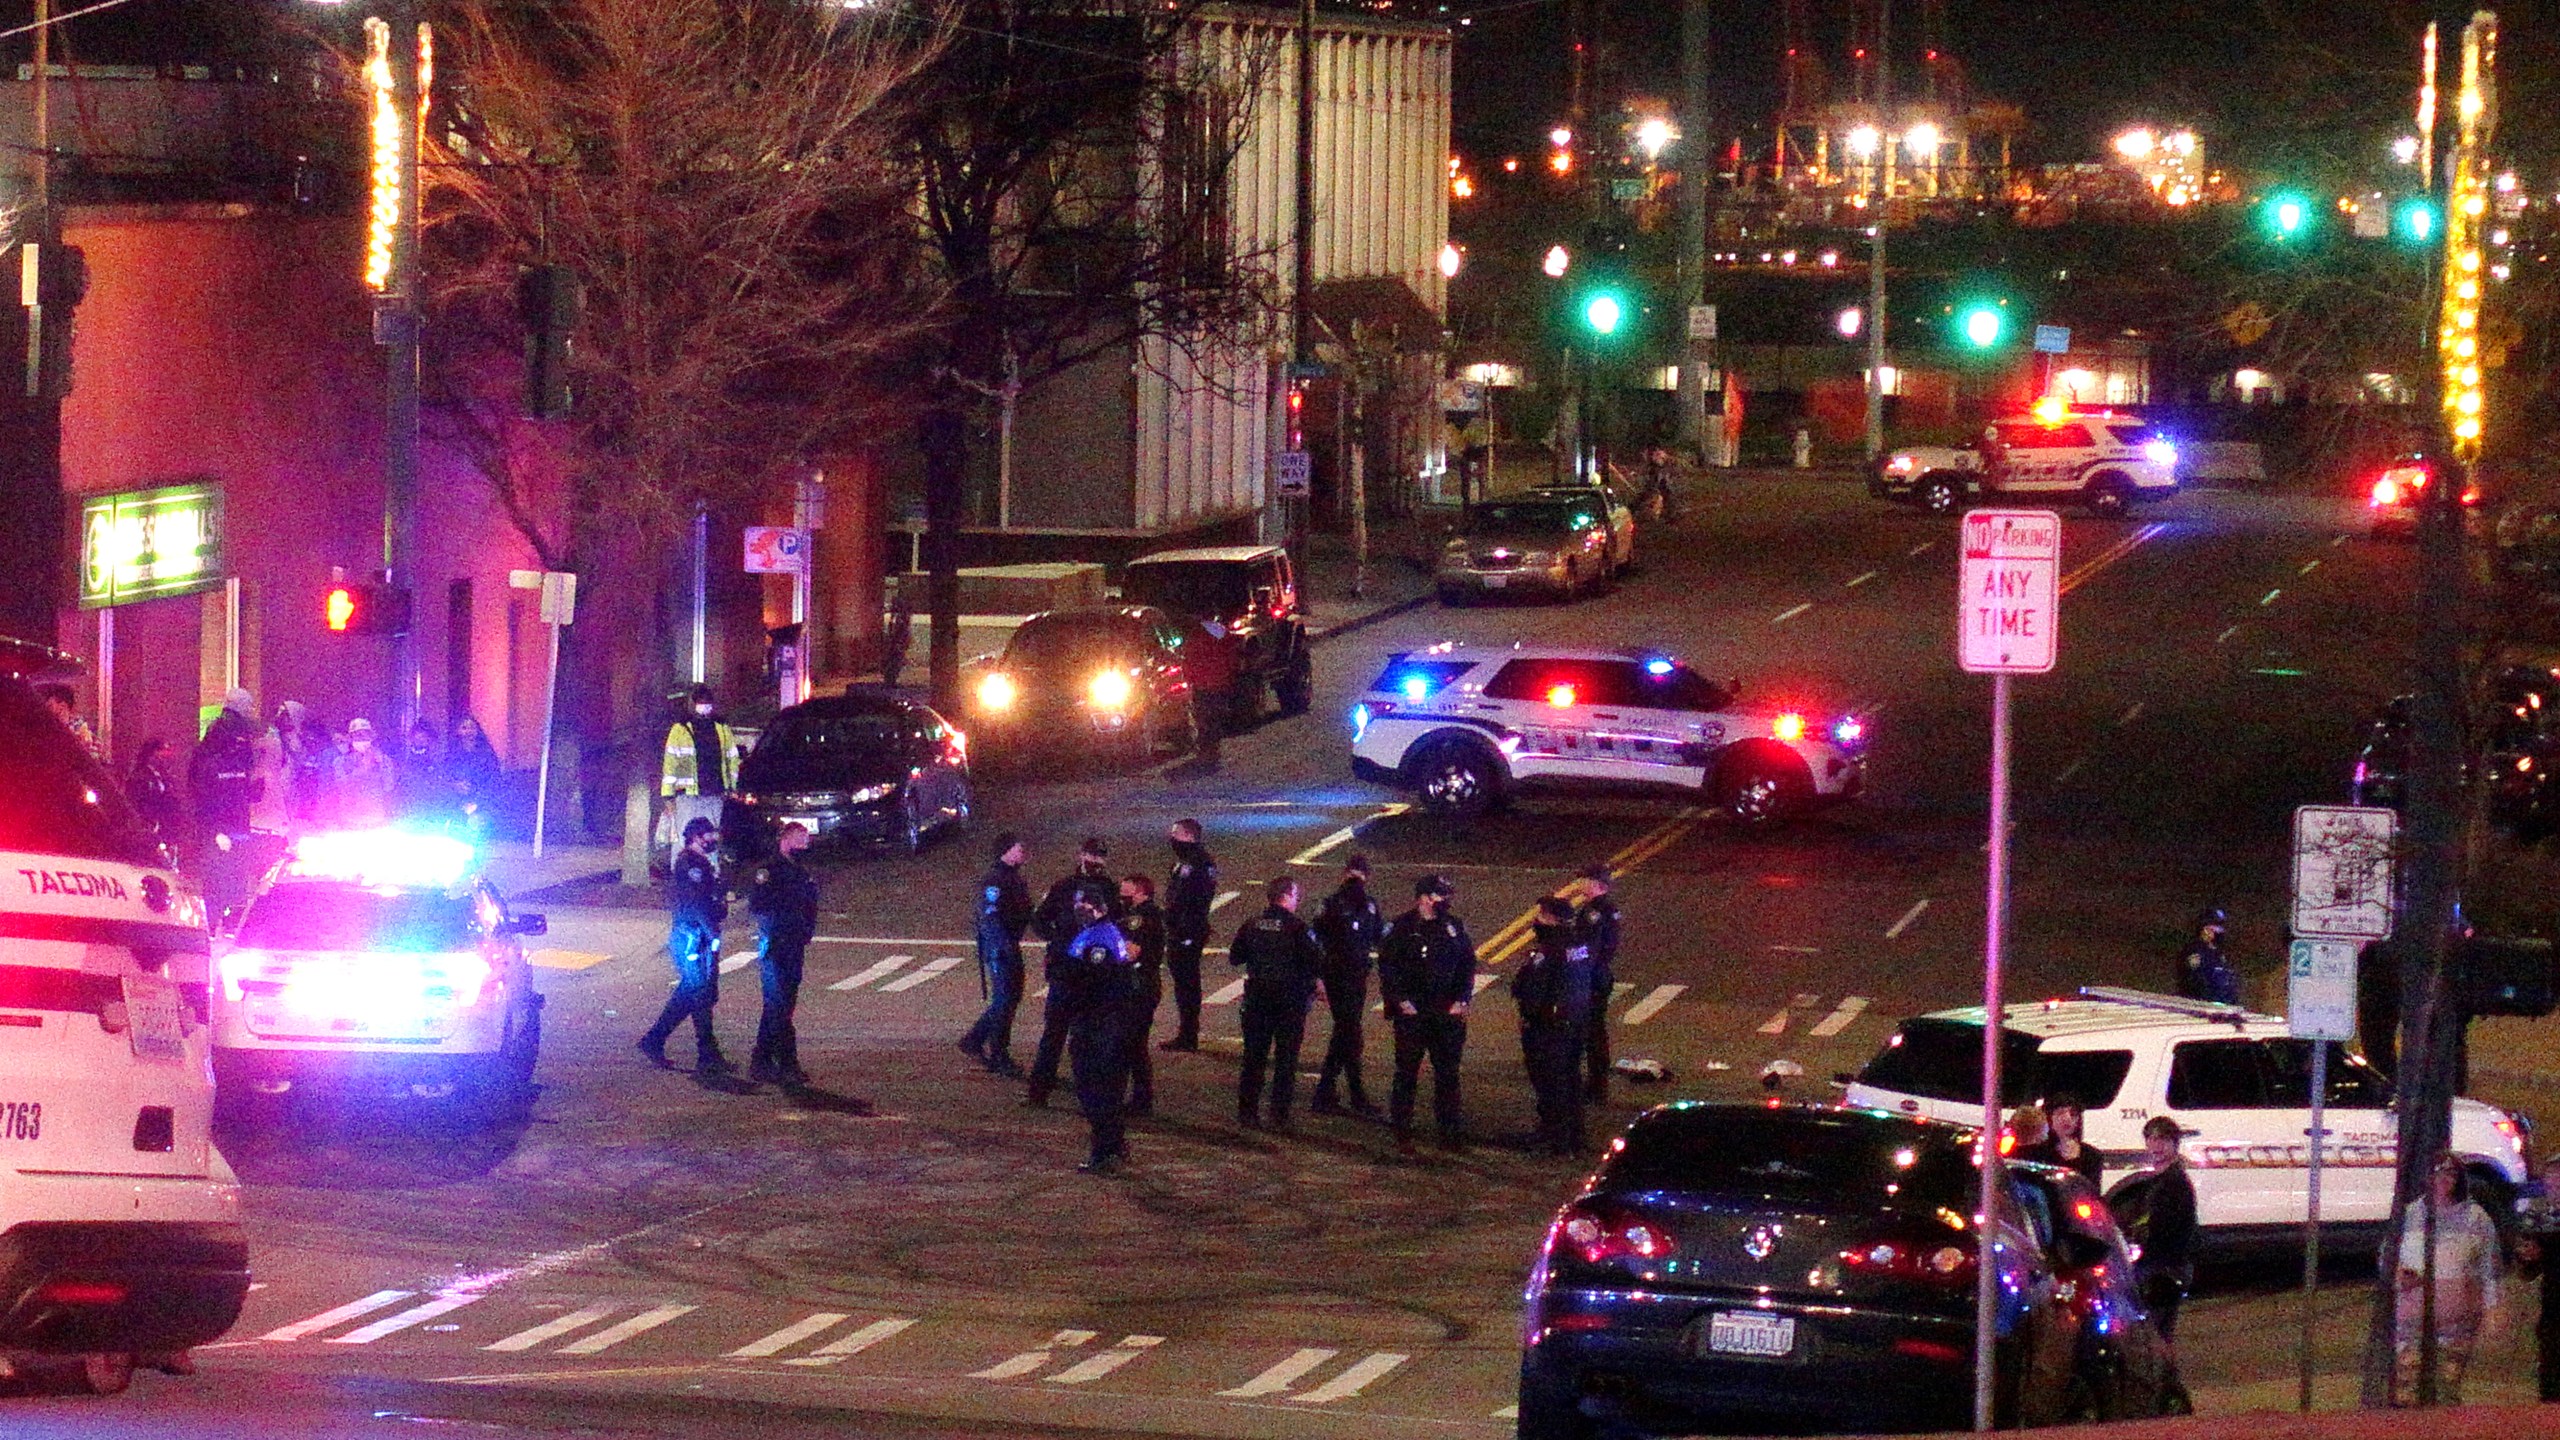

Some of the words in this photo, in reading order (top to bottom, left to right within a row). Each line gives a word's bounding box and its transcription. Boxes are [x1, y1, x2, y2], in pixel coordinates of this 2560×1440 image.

[1966, 522, 1989, 551] NO
[1993, 528, 2051, 547] PARKING
[1983, 569, 2032, 598] ANY
[1979, 607, 2036, 637] TIME
[18, 868, 128, 901] TACOMA
[2294, 947, 2311, 969] 2
[2343, 1131, 2399, 1143] TACOMA
